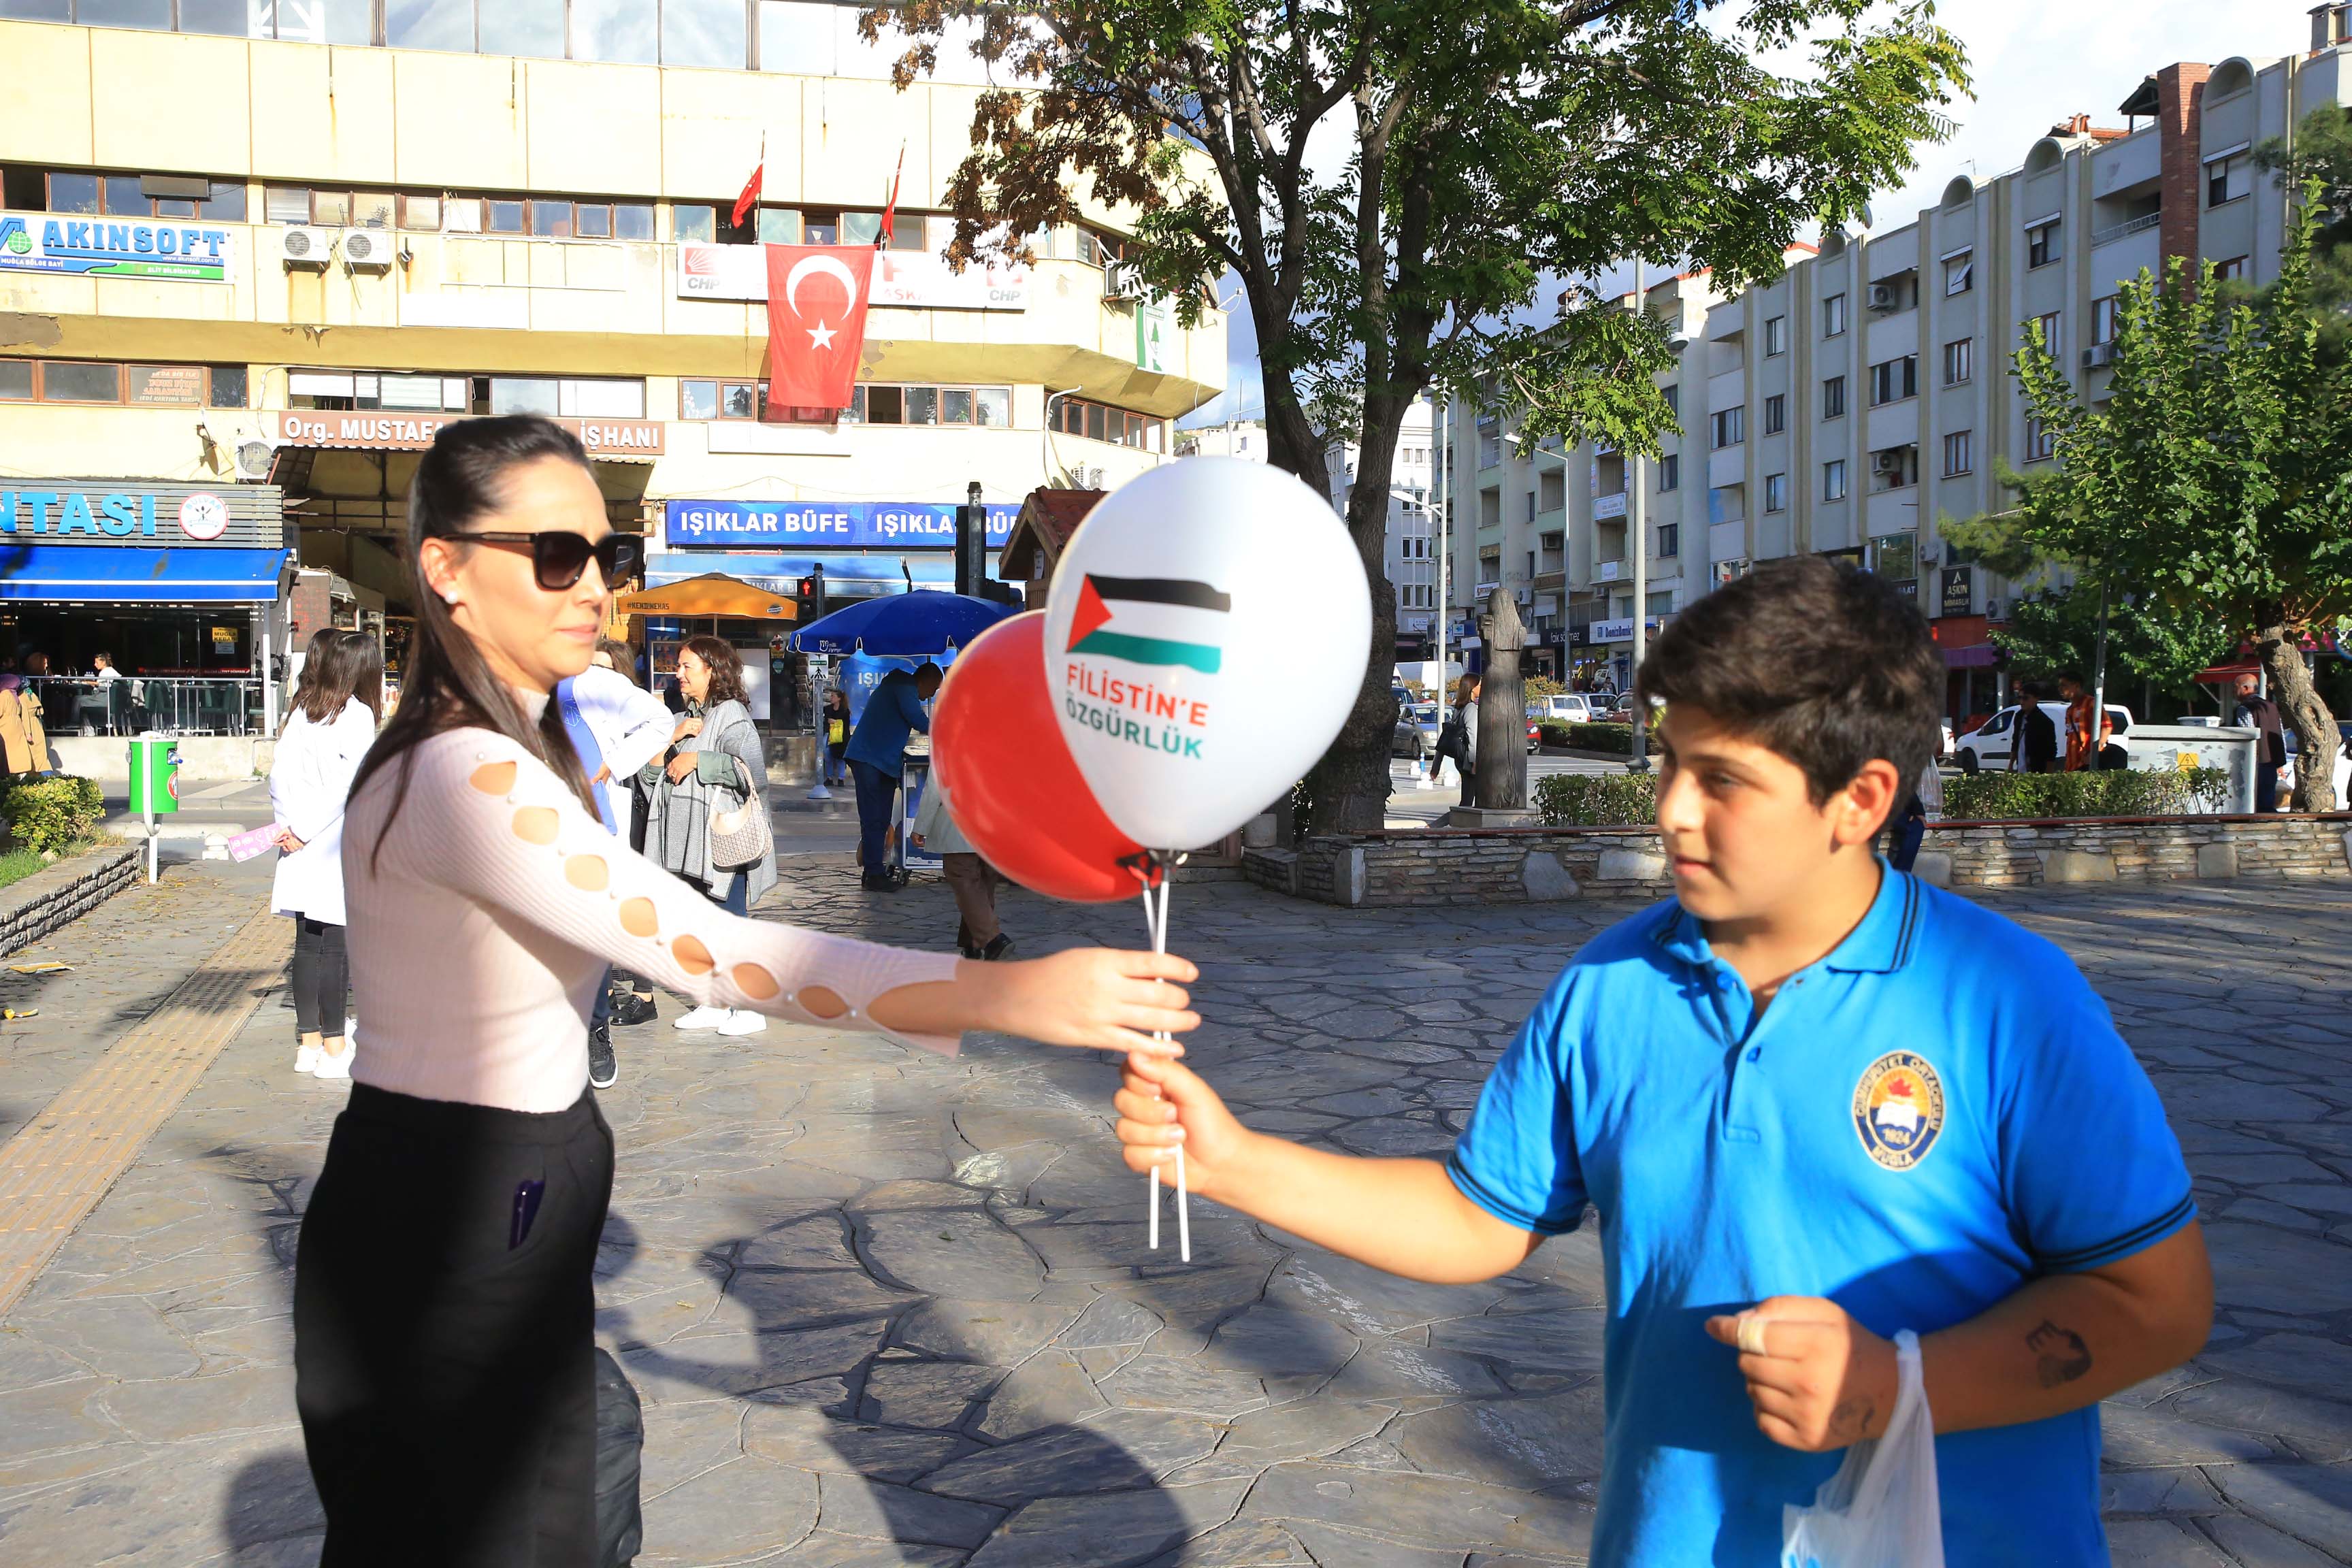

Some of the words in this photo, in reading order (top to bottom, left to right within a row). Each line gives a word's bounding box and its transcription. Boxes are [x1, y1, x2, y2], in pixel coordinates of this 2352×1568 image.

[42, 220, 225, 256] AKINSOFT
[687, 277, 721, 290] CHP
[990, 290, 1021, 301] CHP
[284, 417, 334, 444] Org.
[681, 512, 779, 536] IŞIKLAR
[785, 509, 849, 533] BÜFE
[877, 514, 954, 538] IŞIKLA
[1605, 625, 1632, 638] DenizBank
[1066, 660, 1209, 727] FİLİSTİN'E
[1065, 690, 1203, 760] ÖZGÜRLÜK
